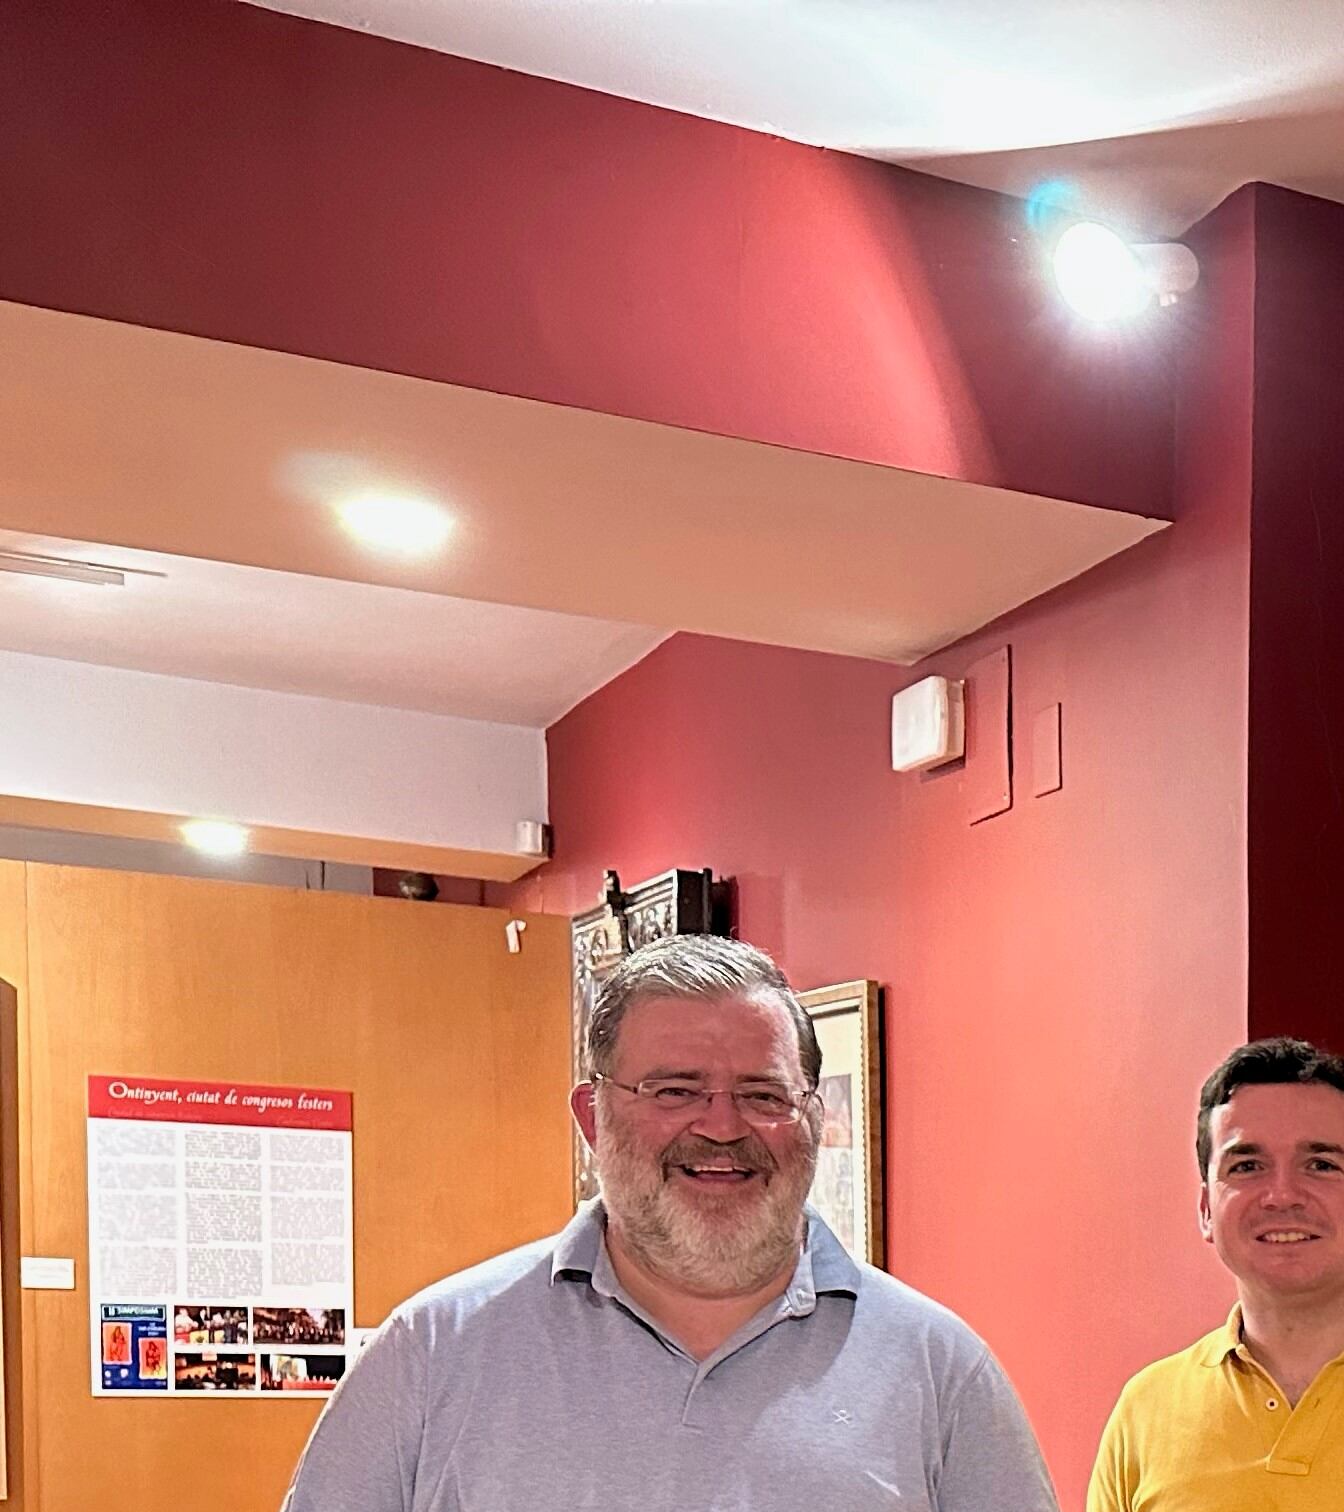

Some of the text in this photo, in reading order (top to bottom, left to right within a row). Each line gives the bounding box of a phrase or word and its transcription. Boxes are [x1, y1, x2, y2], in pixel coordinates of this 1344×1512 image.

[108, 1081, 183, 1105] Ontinyent,
[186, 1091, 221, 1105] ciutat
[224, 1088, 238, 1105] de
[297, 1092, 333, 1111] festers
